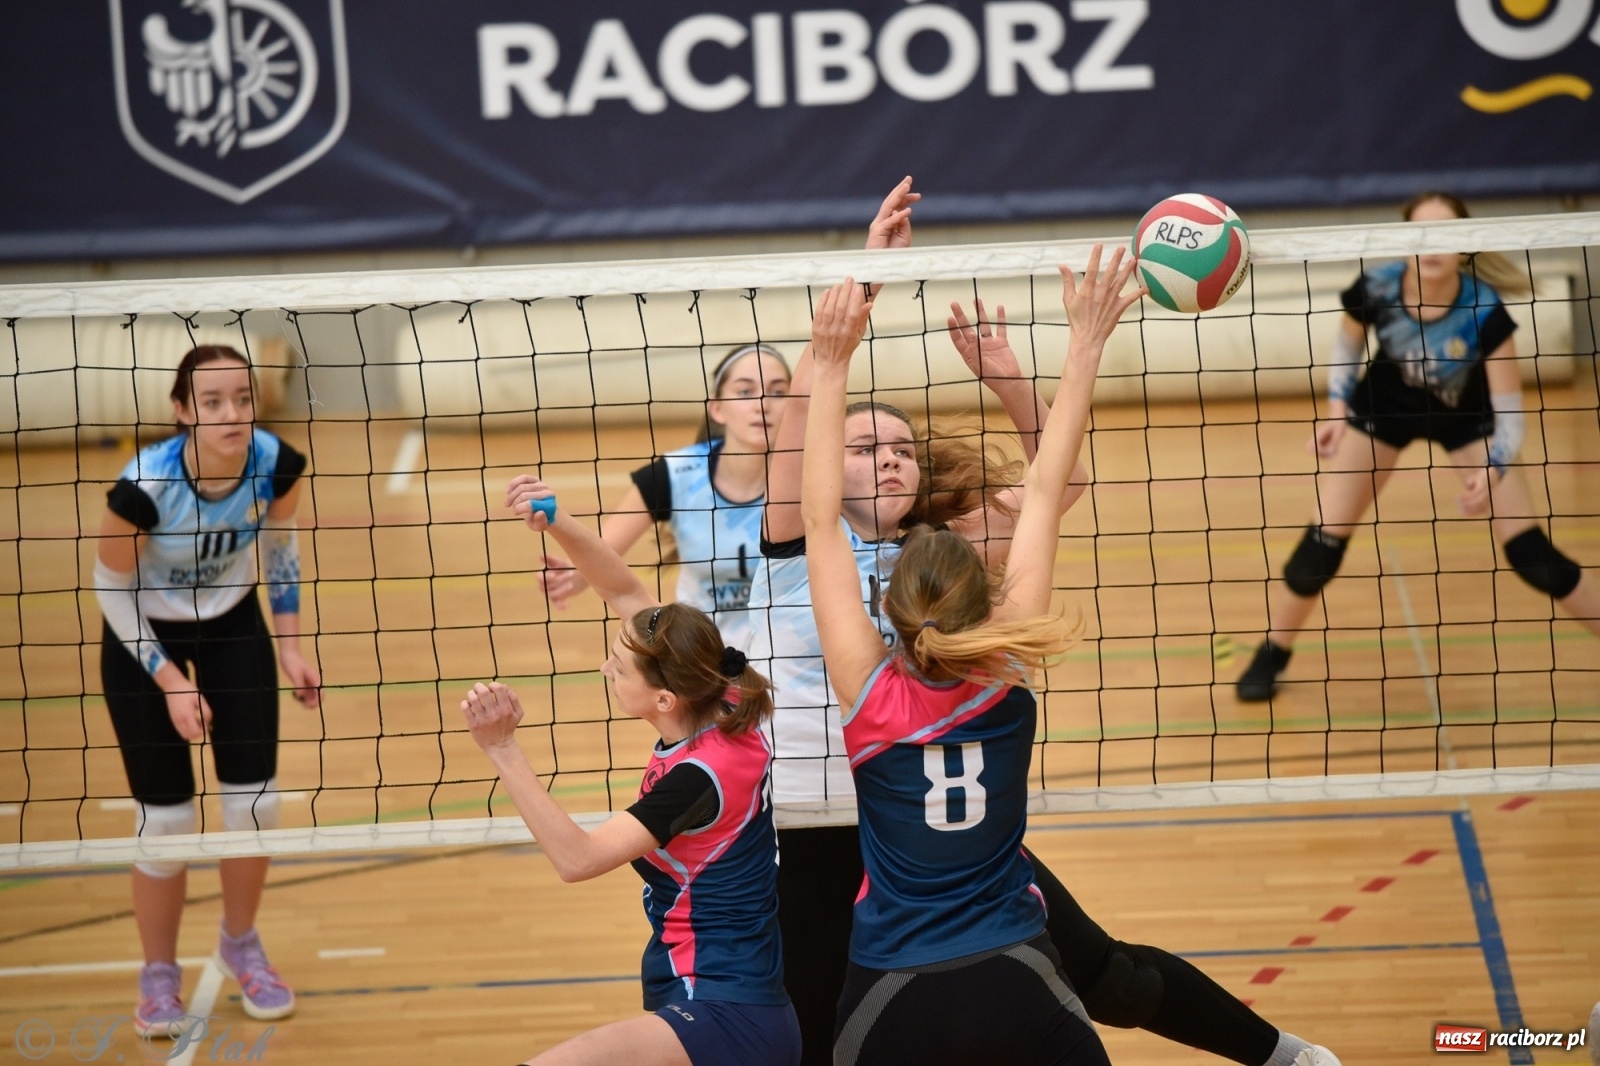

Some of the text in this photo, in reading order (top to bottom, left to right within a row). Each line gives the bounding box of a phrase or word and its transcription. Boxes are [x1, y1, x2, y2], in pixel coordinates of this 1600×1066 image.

[477, 0, 1154, 119] RACIBÓRZ
[1155, 221, 1203, 250] RLPS
[923, 741, 987, 832] 8
